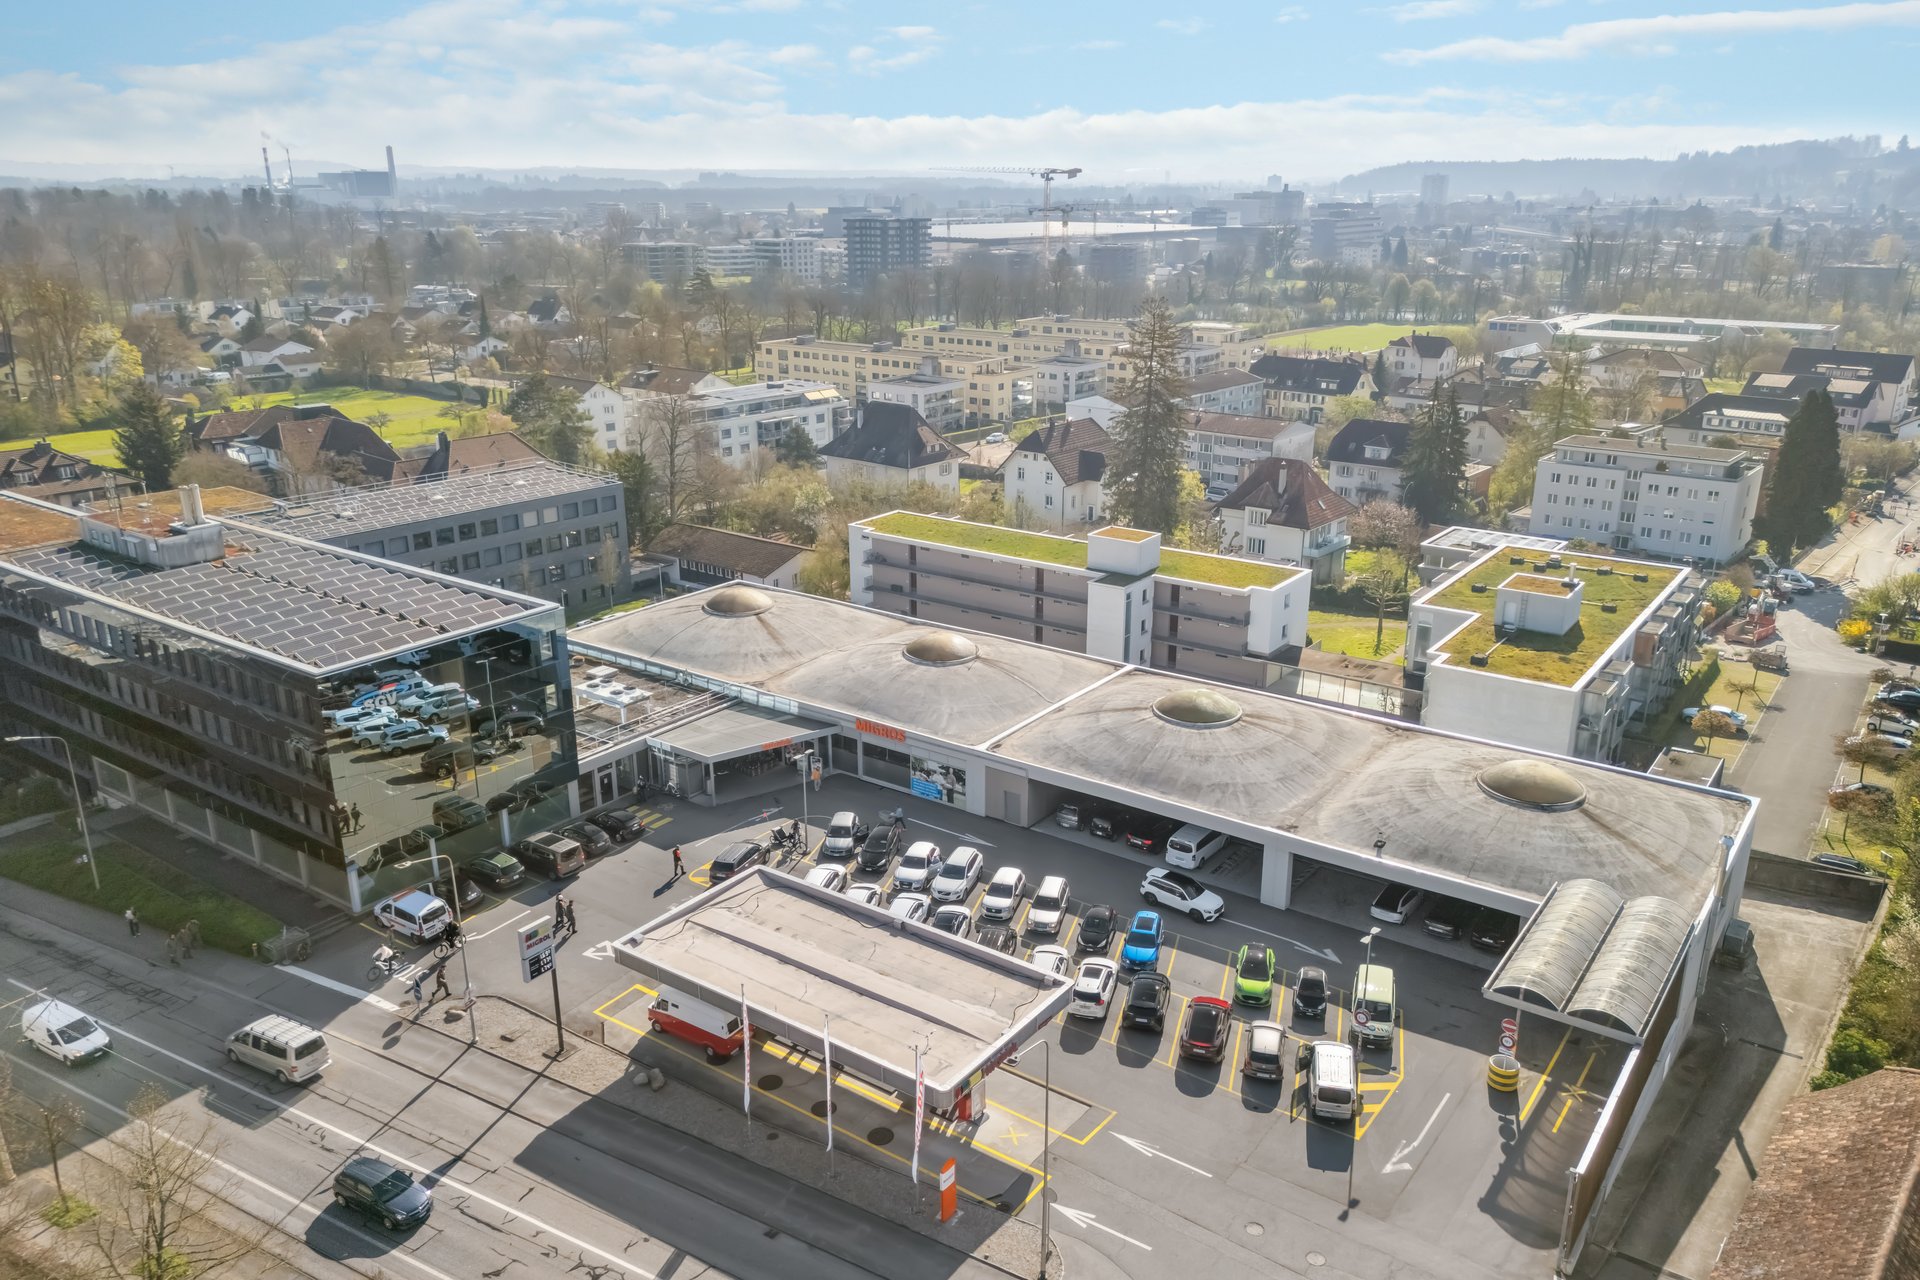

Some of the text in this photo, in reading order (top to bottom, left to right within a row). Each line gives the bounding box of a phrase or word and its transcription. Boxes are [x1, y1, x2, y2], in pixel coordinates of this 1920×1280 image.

[363, 691, 397, 711] SGV
[856, 718, 906, 743] MIGROS
[526, 934, 552, 950] MIGROL
